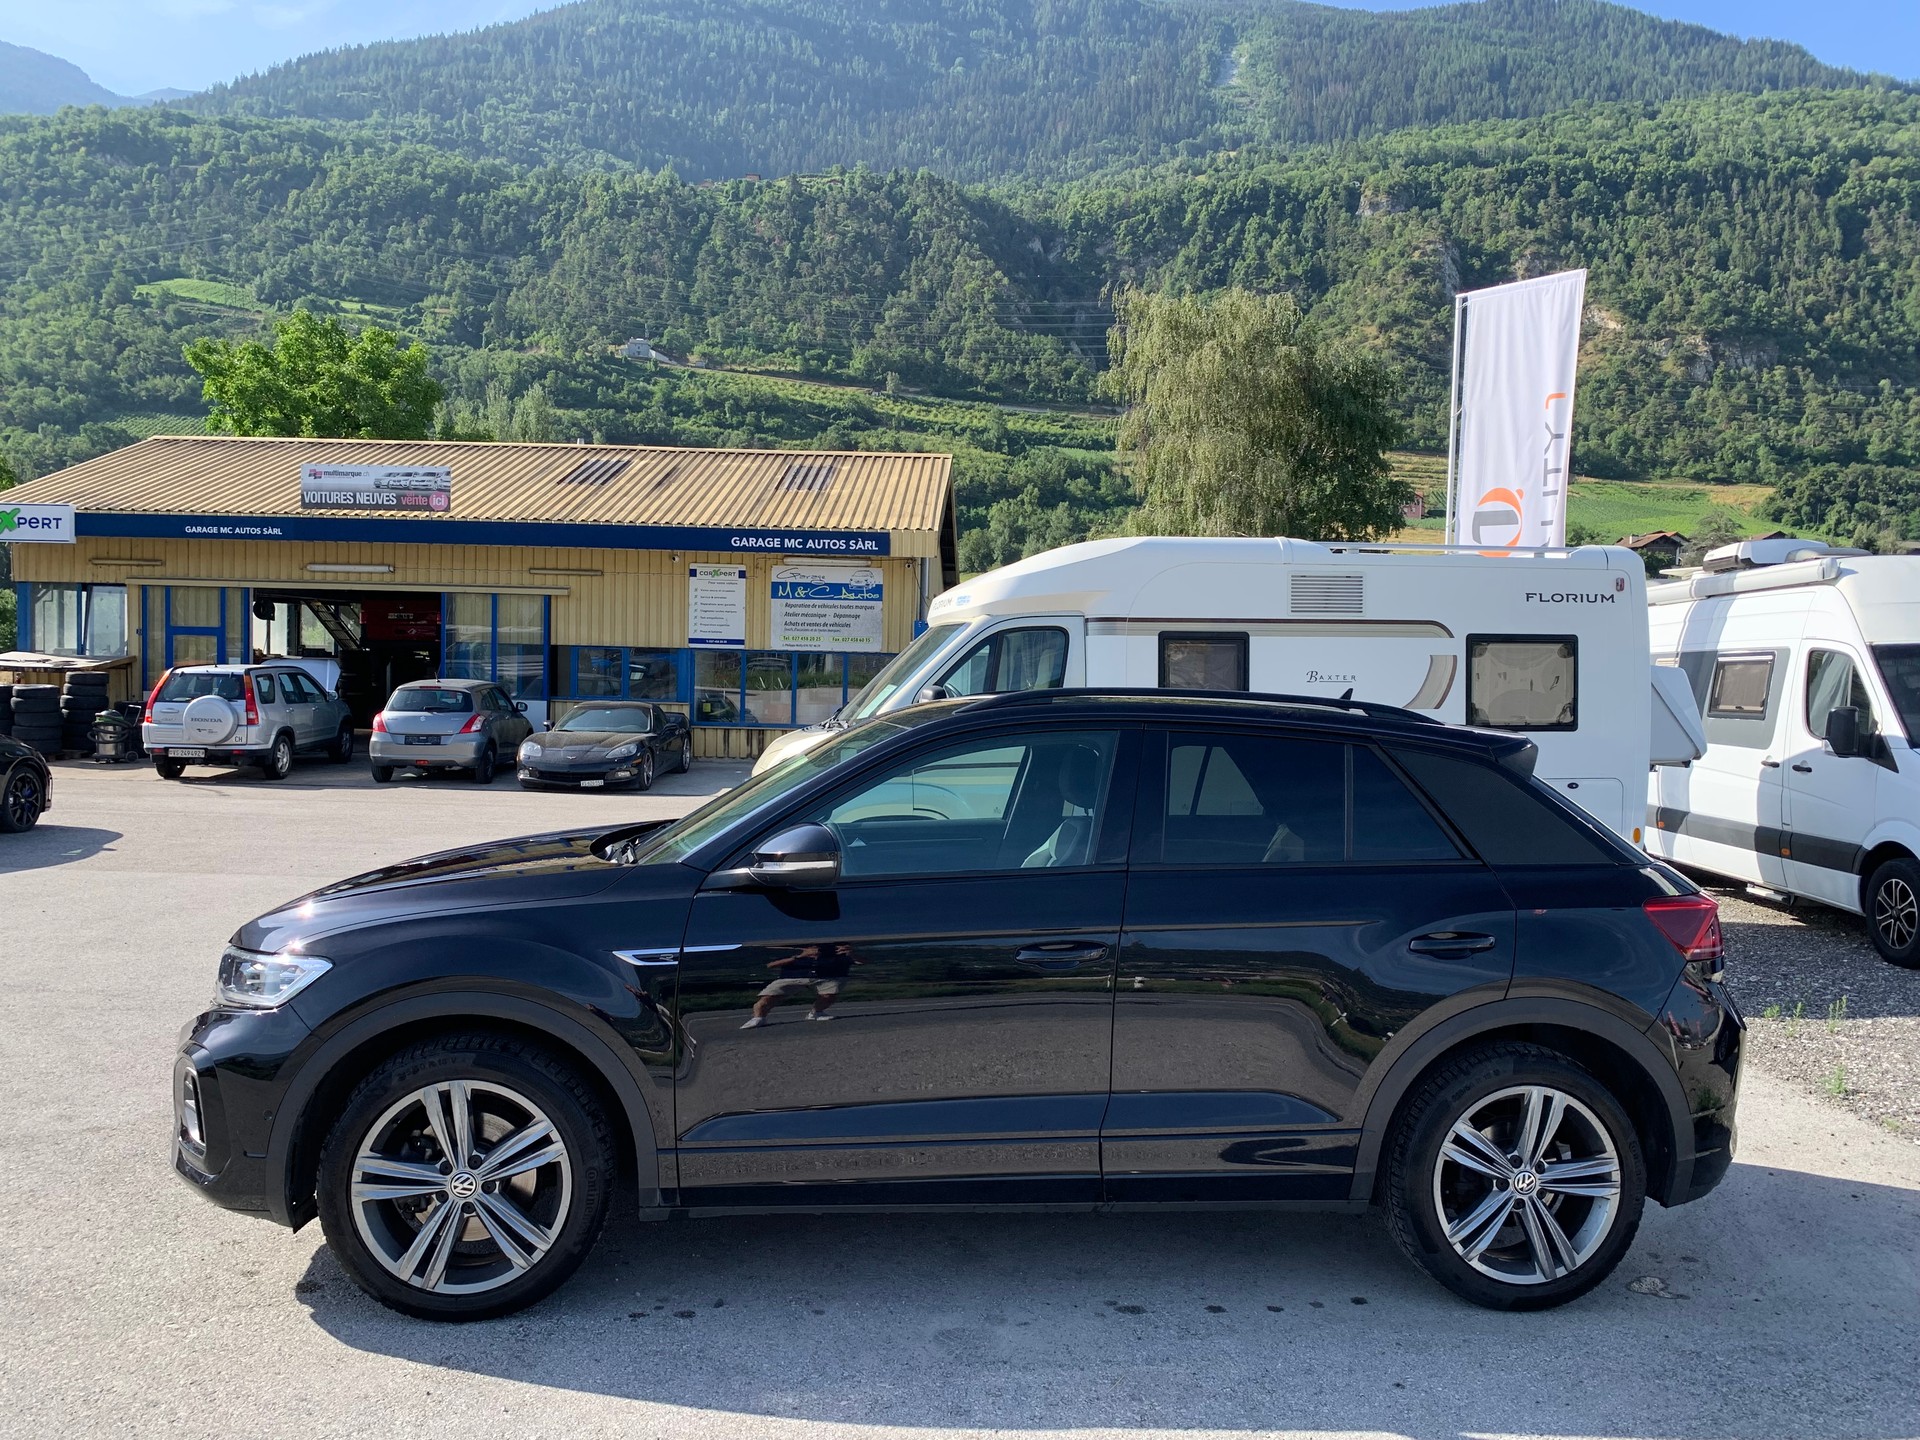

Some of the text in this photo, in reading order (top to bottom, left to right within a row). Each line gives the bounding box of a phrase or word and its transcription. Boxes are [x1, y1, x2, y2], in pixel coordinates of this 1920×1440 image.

[303, 491, 396, 505] VOITURES NEUVES
[401, 494, 445, 506] vente ici
[185, 526, 219, 534] GARAGE
[234, 527, 261, 535] AUTOS
[731, 537, 781, 548] GARAGE
[784, 538, 804, 549] MC
[806, 539, 846, 550] AUTOS
[1525, 592, 1616, 604] FLORIUM
[800, 611, 827, 619] mécanique
[234, 735, 243, 743] CH
